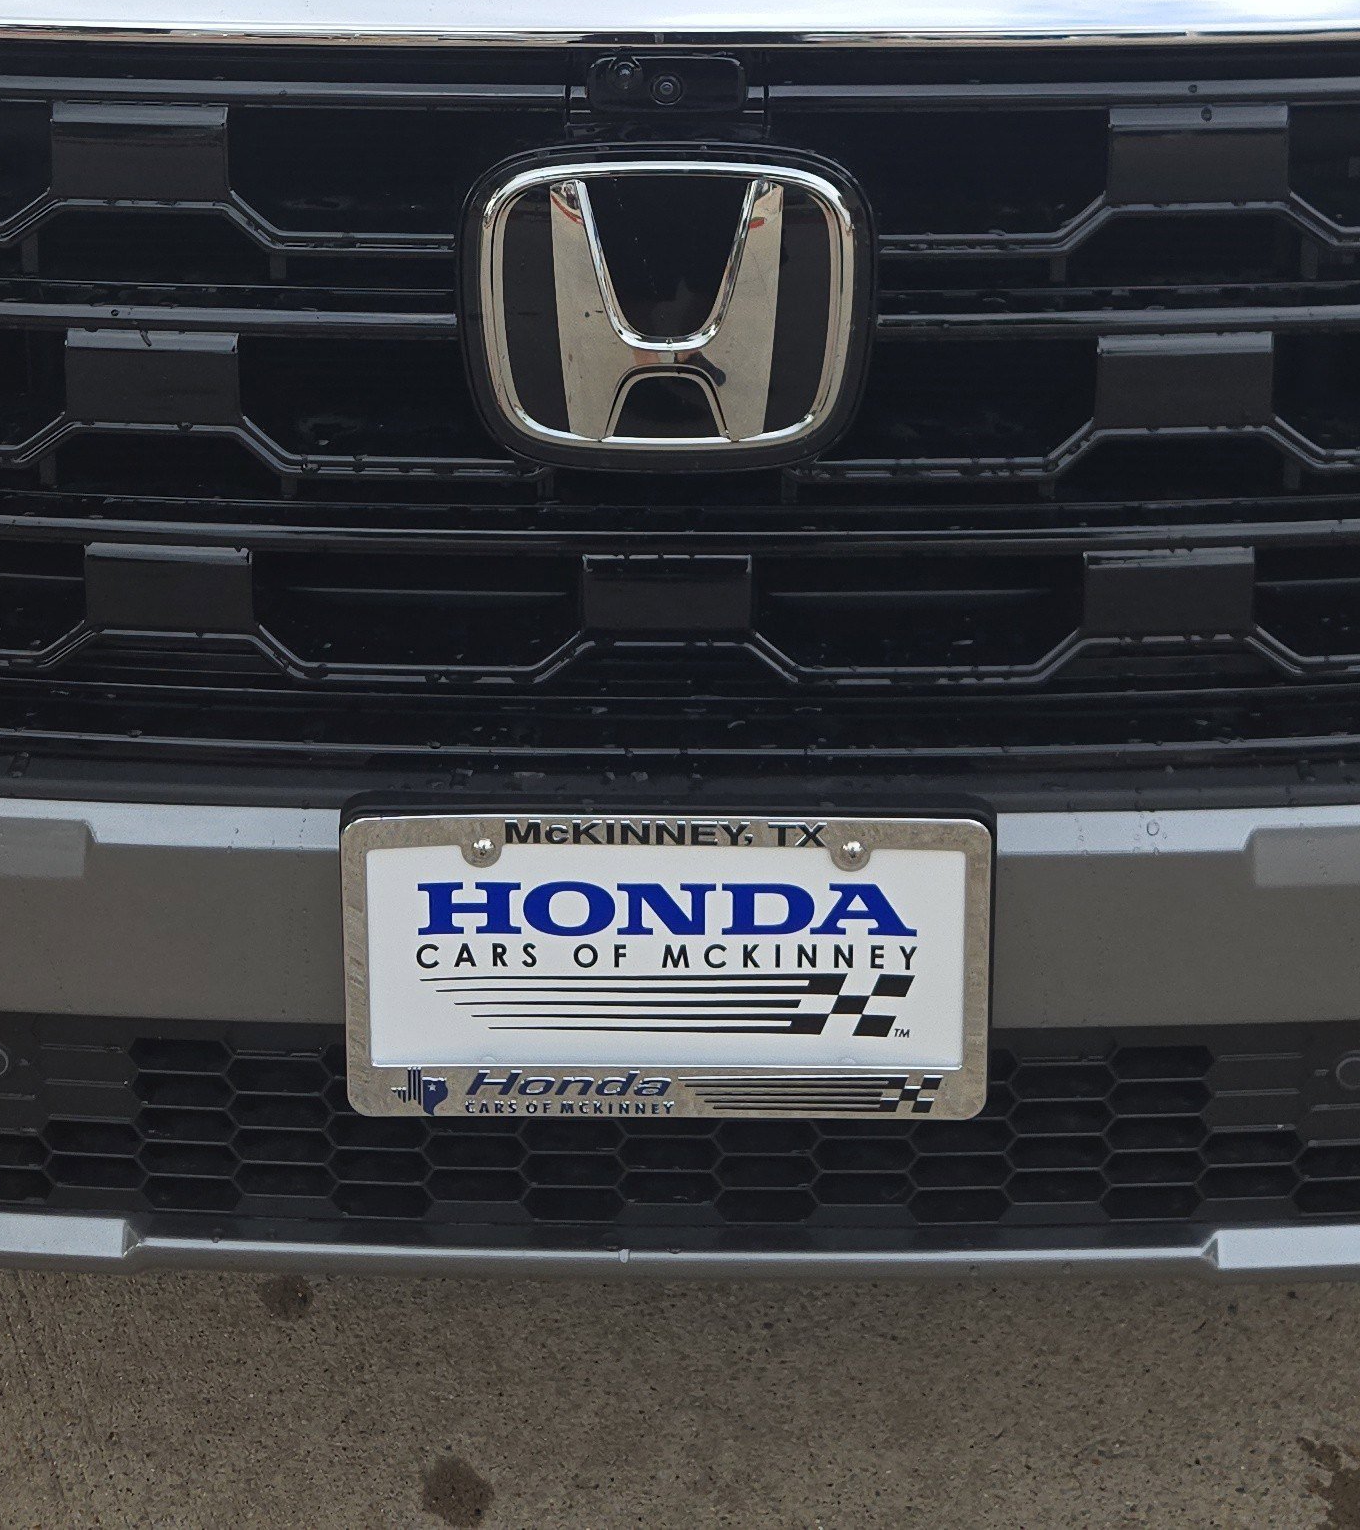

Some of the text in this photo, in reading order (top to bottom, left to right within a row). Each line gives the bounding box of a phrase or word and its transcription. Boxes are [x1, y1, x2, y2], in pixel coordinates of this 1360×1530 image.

[767, 821, 828, 847] TX
[416, 881, 918, 938] HONDA
[416, 943, 918, 971] CARS OF MCKINNEY
[465, 1069, 672, 1097] Honda
[465, 1100, 675, 1115] CARS OF MCKINNEY
